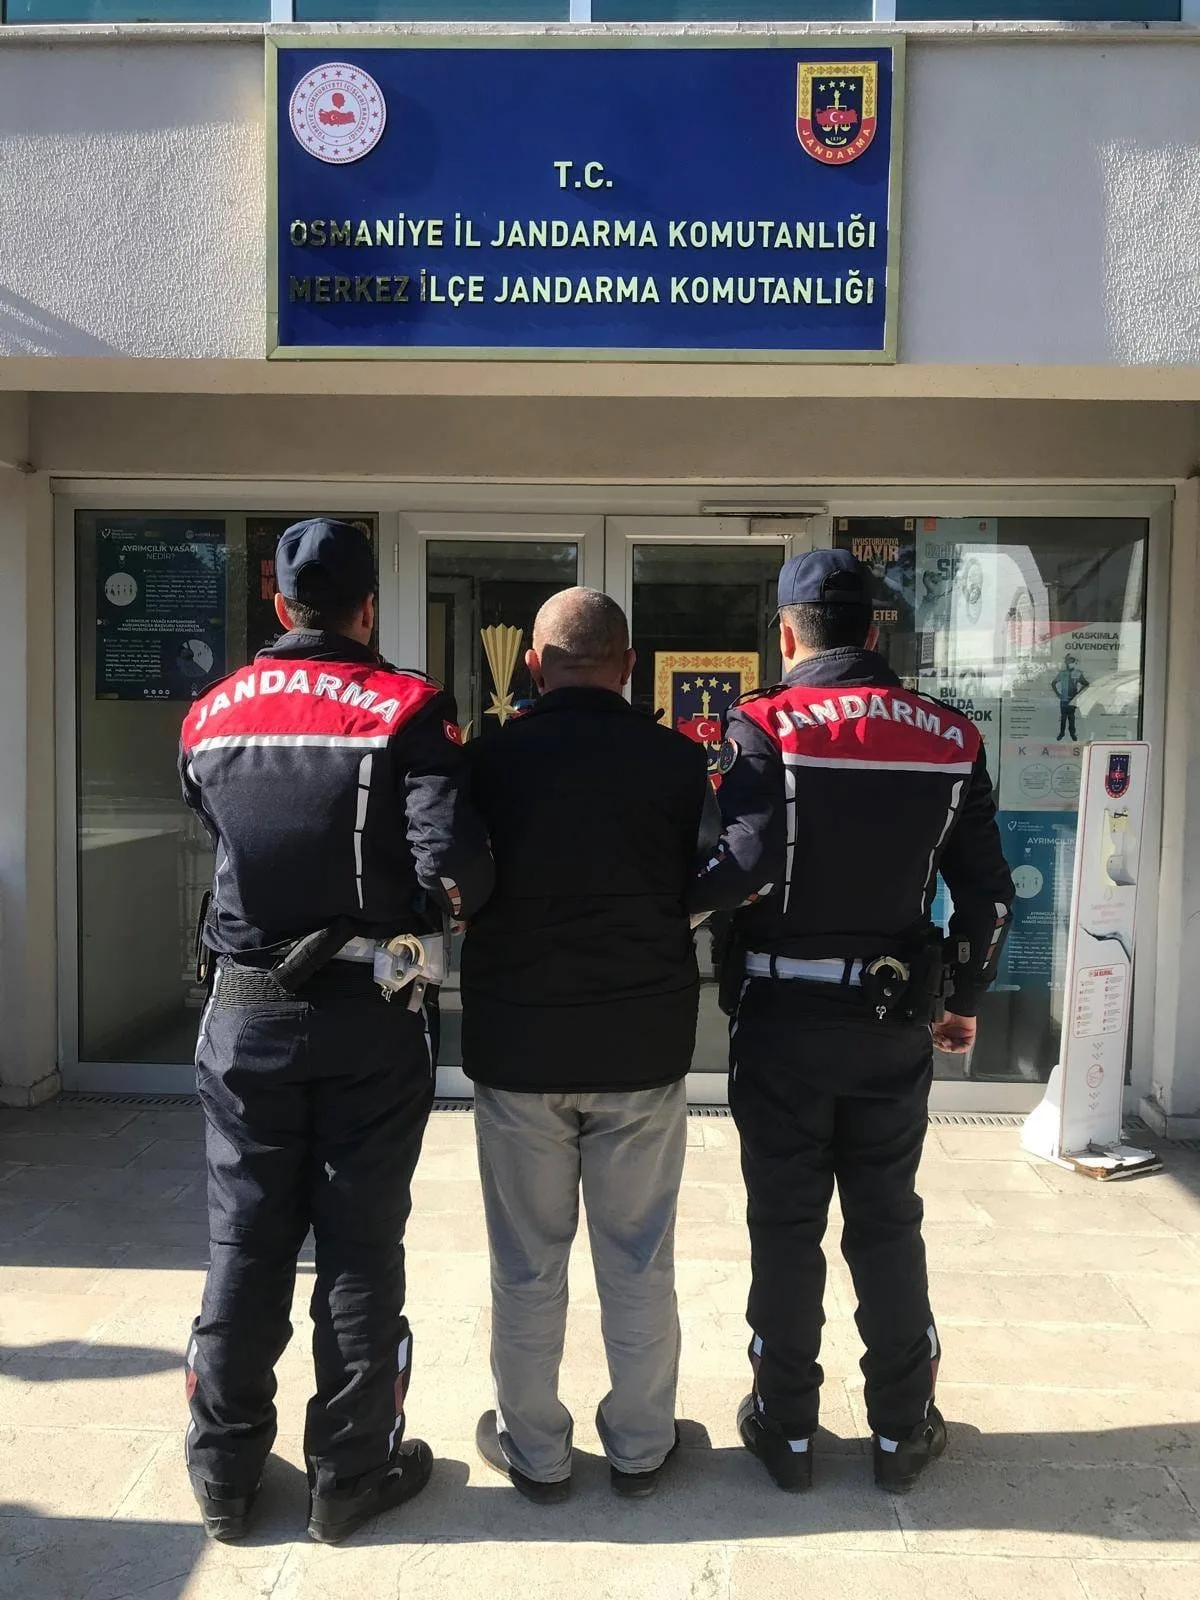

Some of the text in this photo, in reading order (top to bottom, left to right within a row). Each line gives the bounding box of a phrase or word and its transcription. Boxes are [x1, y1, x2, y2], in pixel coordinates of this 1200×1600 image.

[803, 128, 871, 159] JANDARMA
[554, 161, 613, 189] T.C.
[289, 213, 876, 249] OSMANİYE İL JANDARMA KOMUTANLIĞI
[289, 268, 874, 307] MERKEZ İLÇE JANDARMA KOMUTANLIĞI
[852, 545, 899, 562] HAYIR
[1072, 632, 1119, 640] KASKIMLA
[195, 670, 400, 730] JANDARMA
[940, 688, 957, 698] BU
[776, 694, 965, 749] JANDARMA
